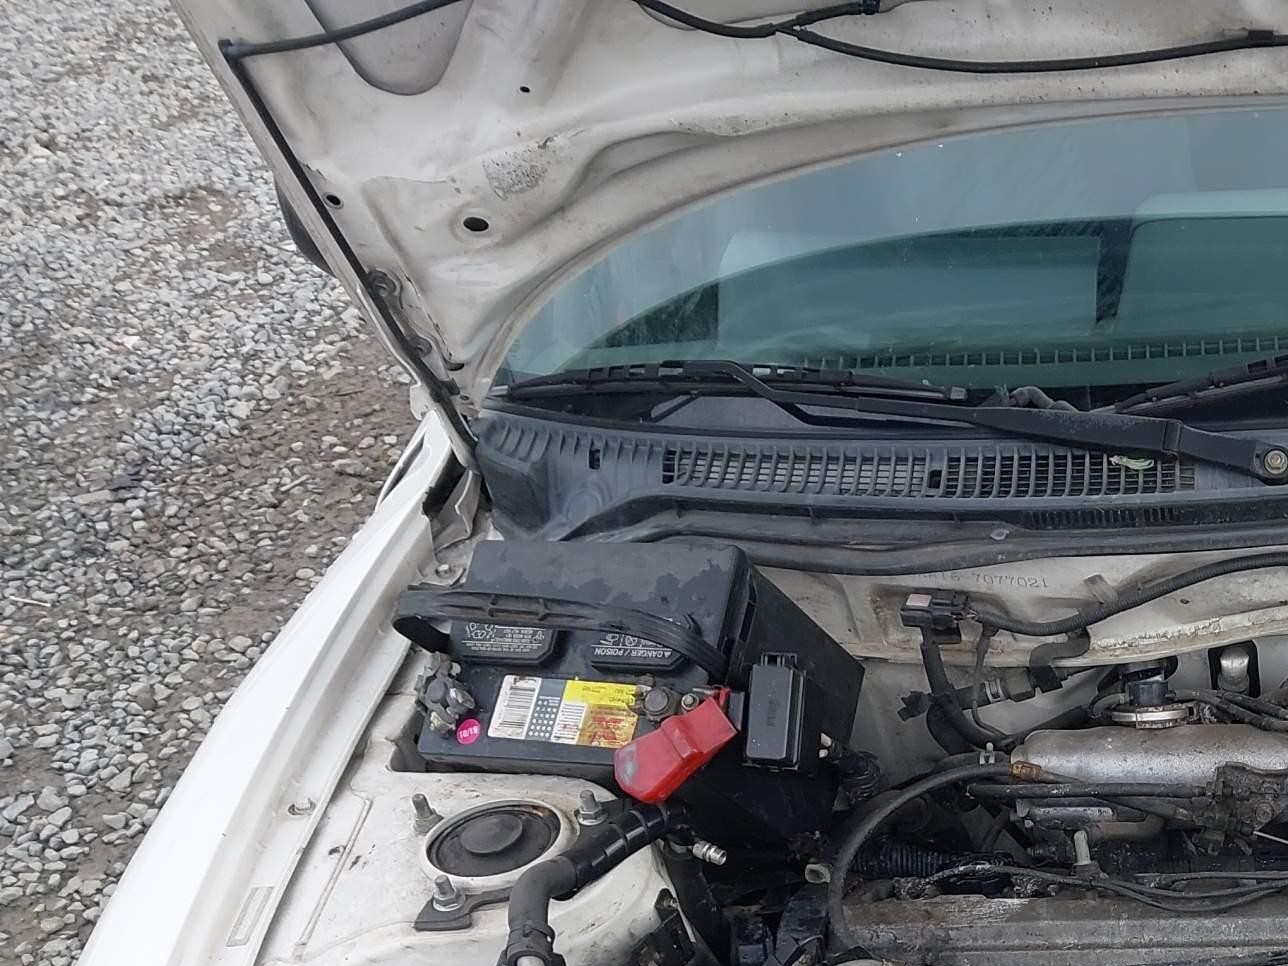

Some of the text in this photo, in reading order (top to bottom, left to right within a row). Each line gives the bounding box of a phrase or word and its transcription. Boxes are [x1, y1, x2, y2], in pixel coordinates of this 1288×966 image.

[973, 573, 1048, 588] 7077021
[593, 647, 624, 656] POISON
[630, 649, 664, 658] DANGER
